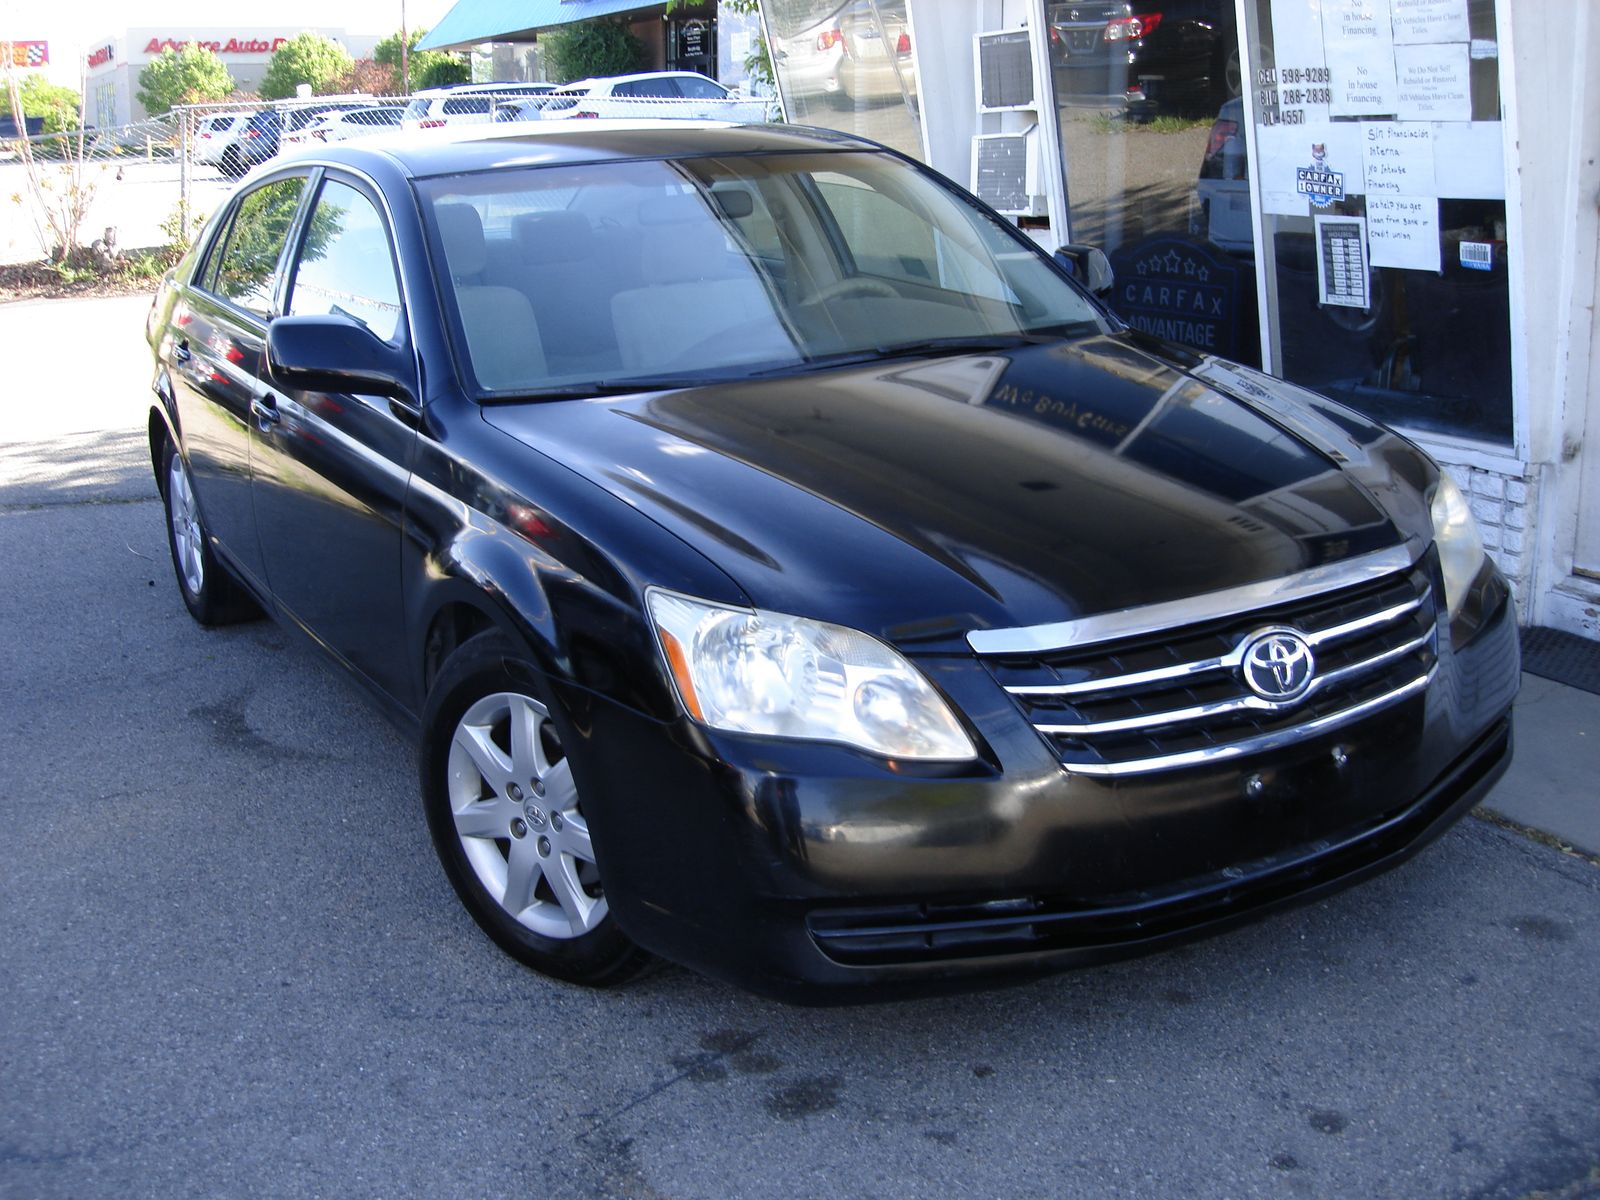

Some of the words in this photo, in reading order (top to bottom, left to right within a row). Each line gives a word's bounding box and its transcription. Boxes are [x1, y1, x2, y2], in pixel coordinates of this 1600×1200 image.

[1342, 25, 1377, 36] Financing
[222, 38, 269, 52] Auto
[1258, 68, 1278, 84] CEL
[1281, 67, 1330, 84] 598-9289
[1356, 66, 1368, 75] No
[1356, 80, 1378, 89] house
[1283, 88, 1331, 105] 288-2838
[1346, 93, 1382, 105] Financing
[1368, 127, 1384, 141] Sin
[1368, 164, 1378, 175] No
[1299, 171, 1341, 185] CARFAX
[1368, 179, 1401, 193] Financing
[1392, 232, 1412, 241] union
[1126, 284, 1223, 316] CARFAX
[1128, 314, 1216, 346] ADVANTAGE
